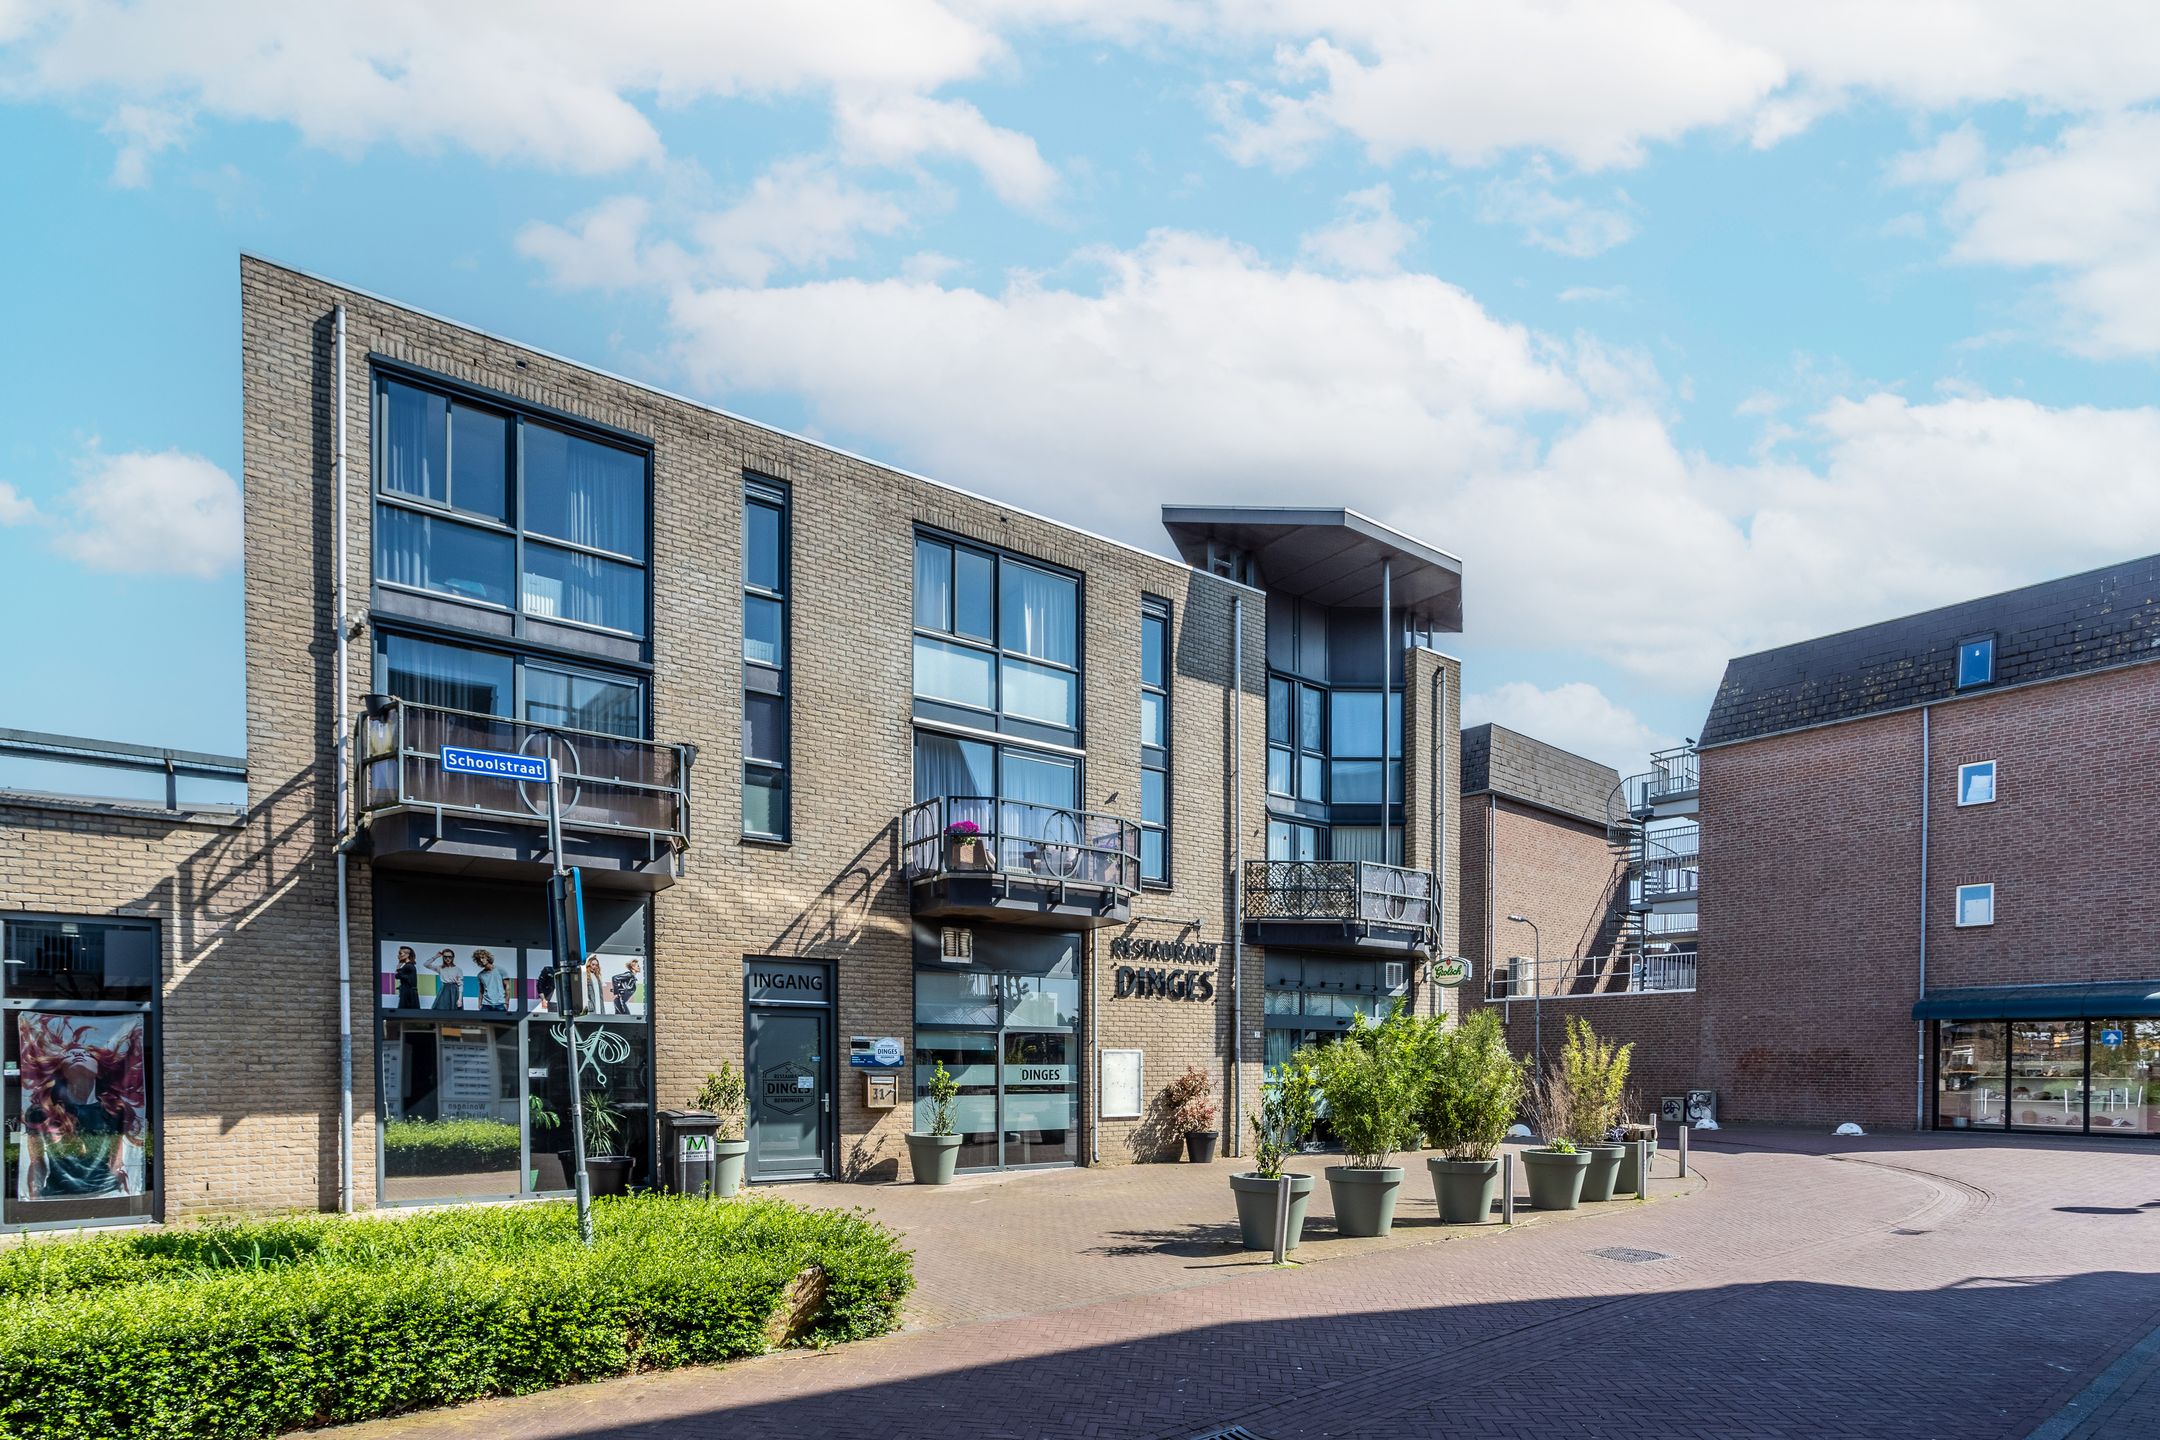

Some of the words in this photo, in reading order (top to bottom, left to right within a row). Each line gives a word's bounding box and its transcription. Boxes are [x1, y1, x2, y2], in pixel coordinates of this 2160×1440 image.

[448, 753, 543, 776] Schoolstraat
[1112, 937, 1218, 963] RESTAURANT
[753, 972, 823, 991] INGANG
[1116, 966, 1214, 1001] DINGES
[1021, 1069, 1060, 1081] DINGES
